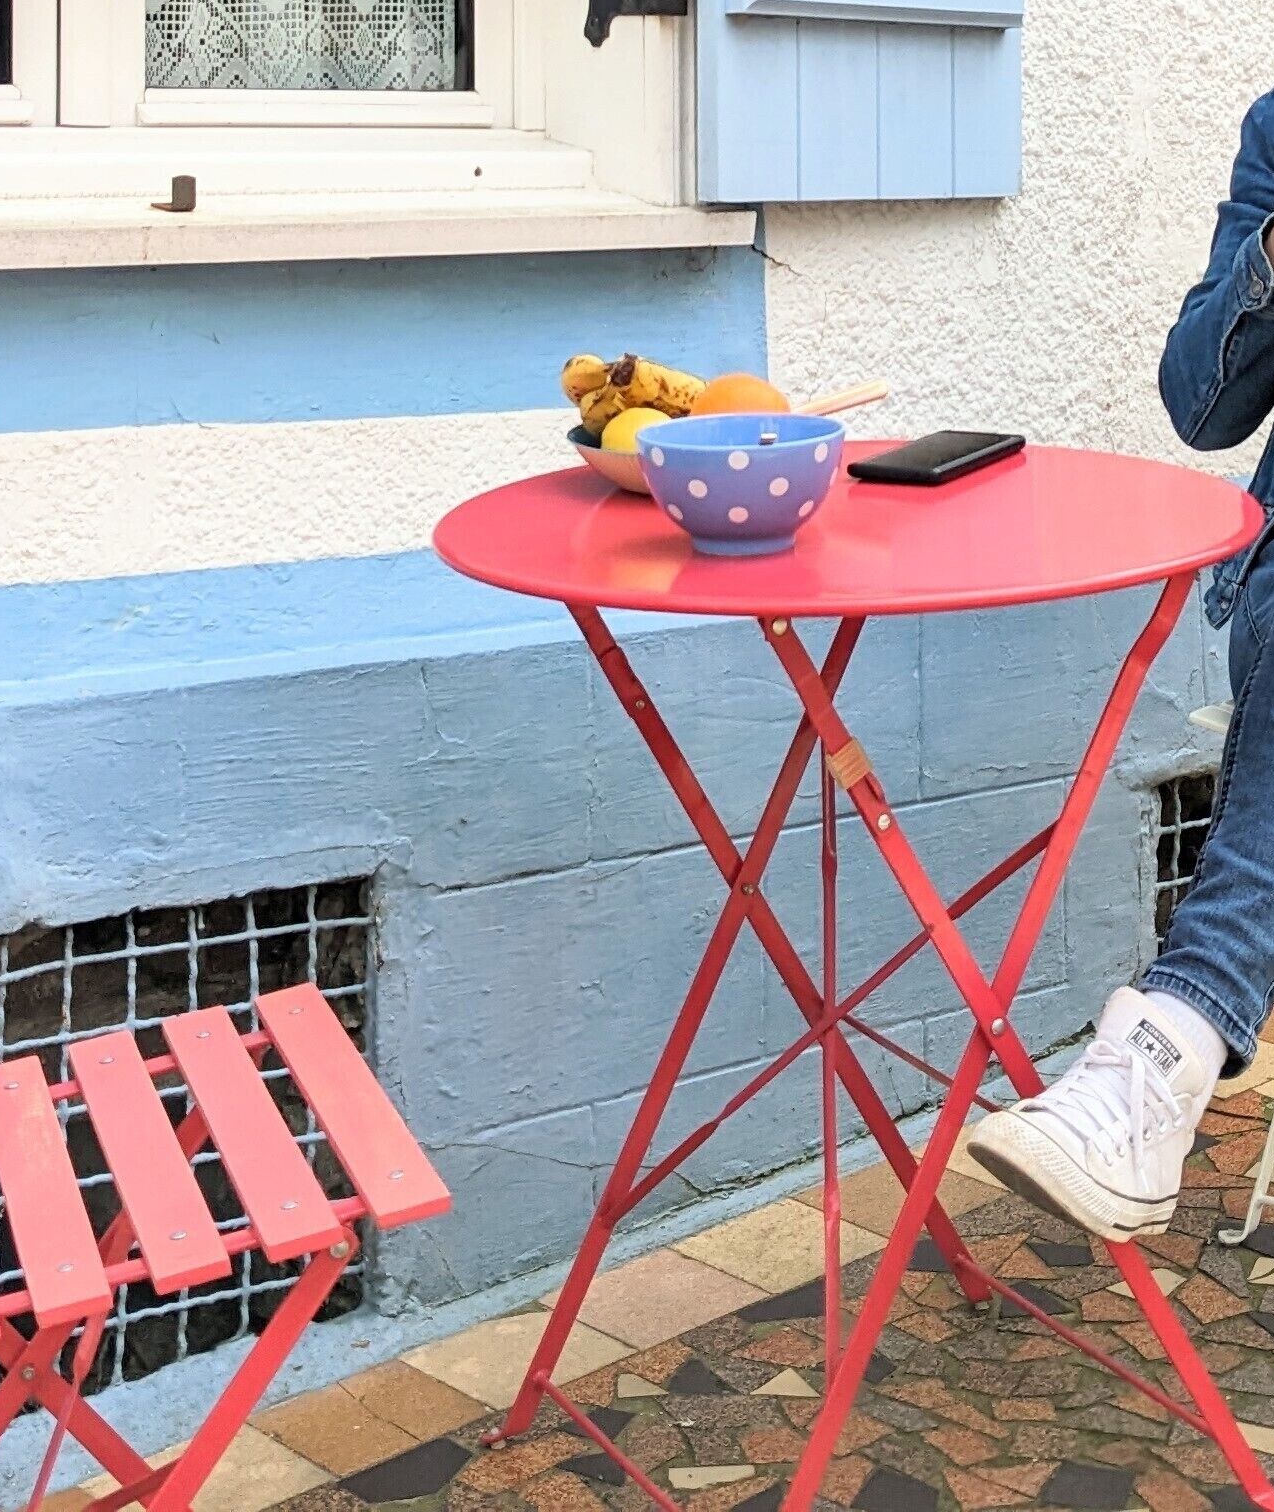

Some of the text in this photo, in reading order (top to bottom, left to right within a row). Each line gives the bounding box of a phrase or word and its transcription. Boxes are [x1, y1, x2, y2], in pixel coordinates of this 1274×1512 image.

[1130, 1029, 1174, 1073] ALL STAR
[1143, 1022, 1179, 1058] CONVERSE
